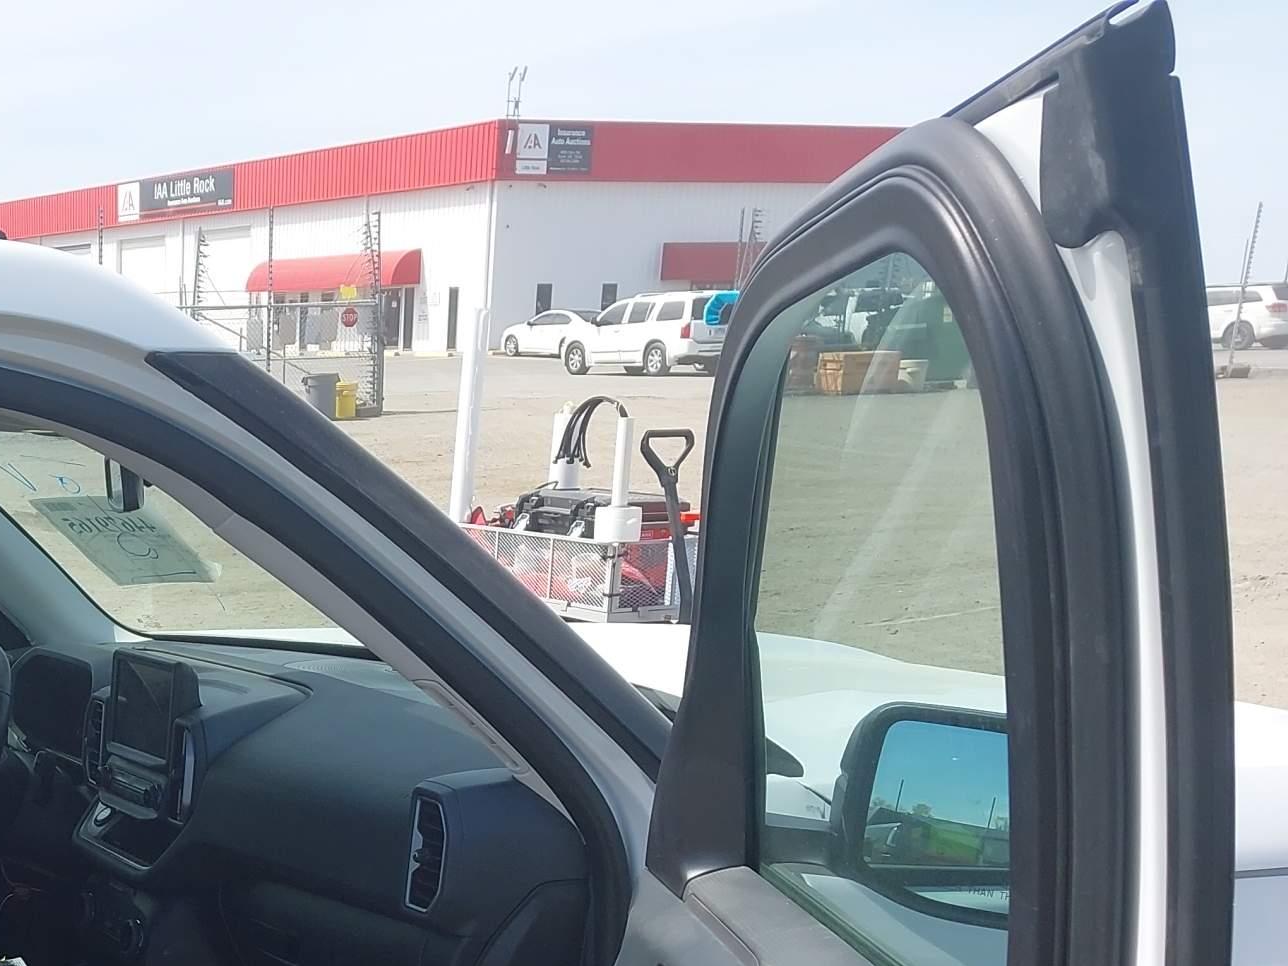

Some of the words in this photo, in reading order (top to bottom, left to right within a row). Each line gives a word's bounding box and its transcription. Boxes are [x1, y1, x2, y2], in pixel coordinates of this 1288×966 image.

[154, 182, 168, 200] IAA
[170, 178, 191, 197] Little
[193, 175, 216, 193] Rock
[342, 313, 358, 322] STOP
